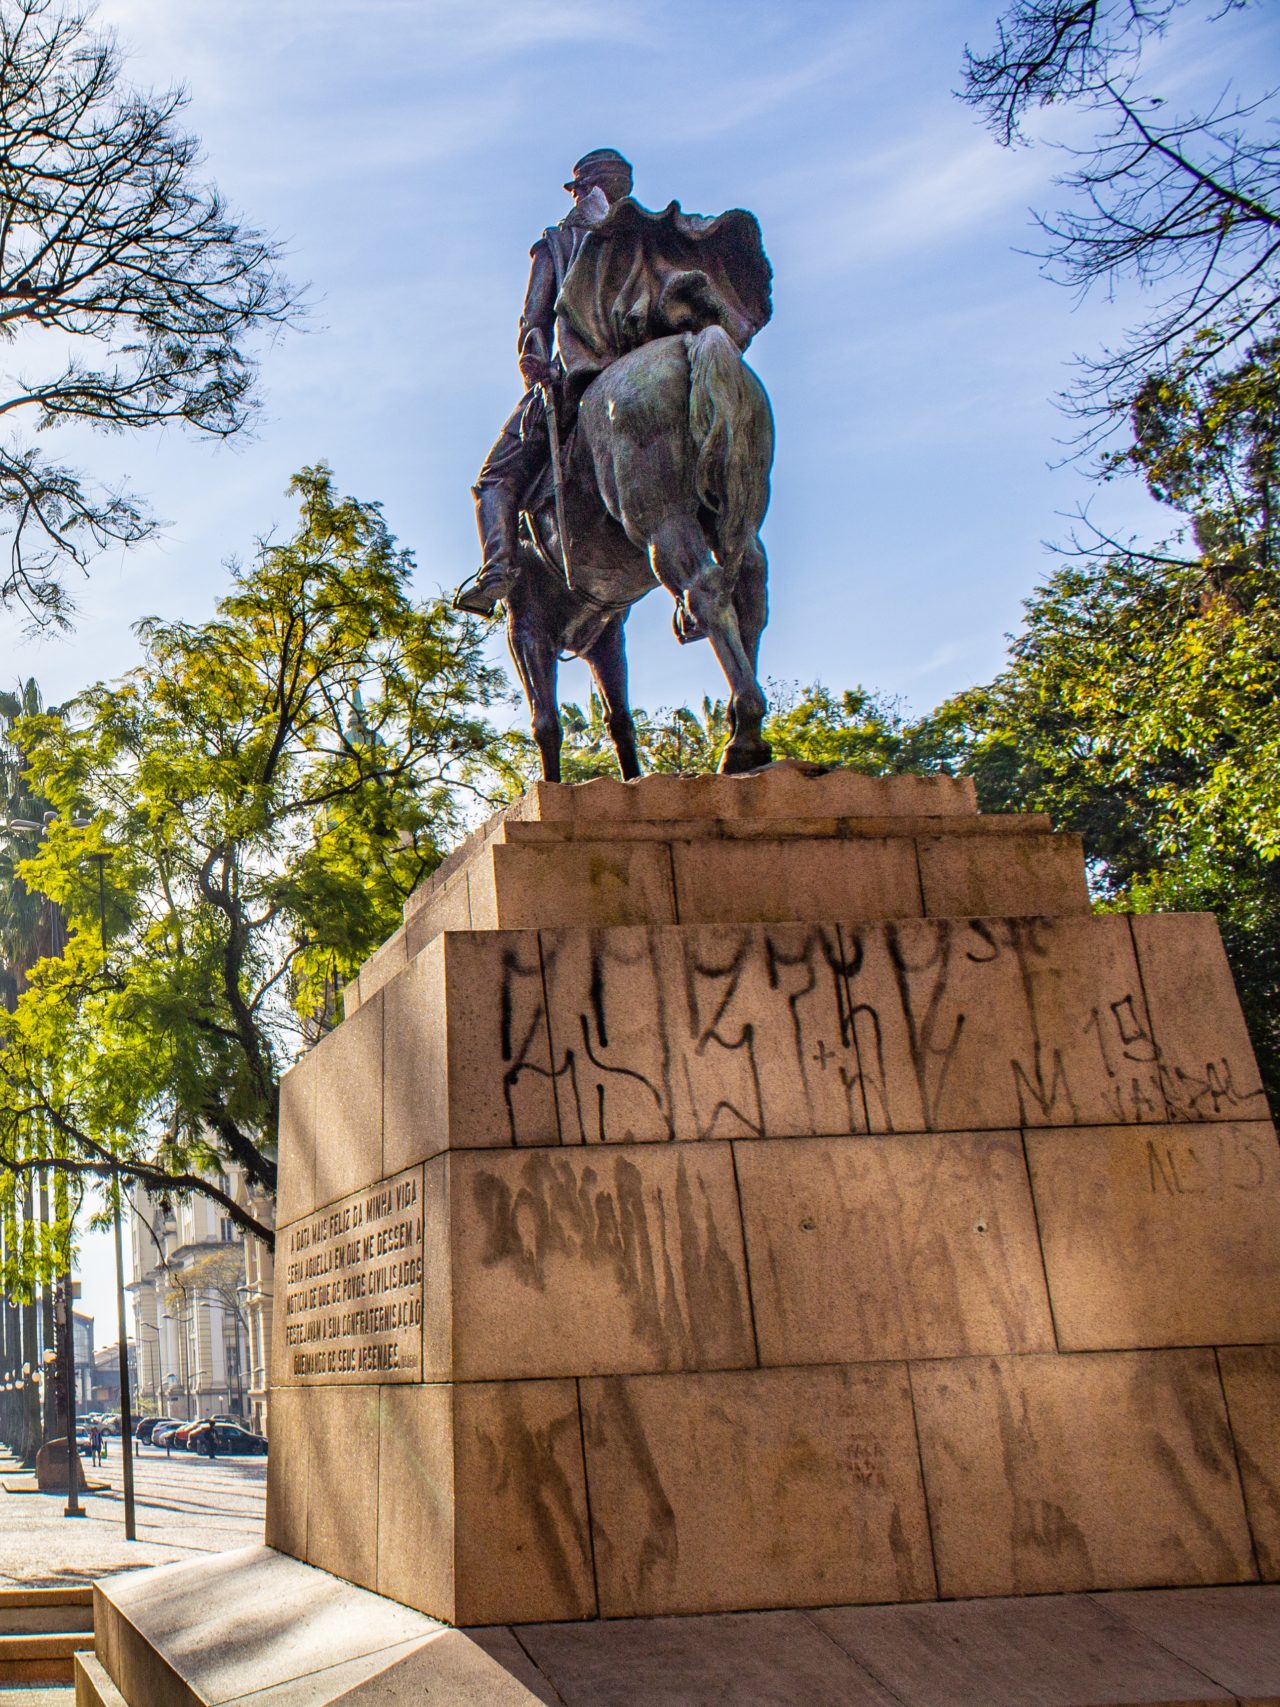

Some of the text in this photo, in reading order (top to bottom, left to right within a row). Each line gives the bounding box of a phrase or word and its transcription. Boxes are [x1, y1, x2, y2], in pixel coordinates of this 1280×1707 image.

[312, 1218, 327, 1245] MAIS
[330, 1208, 350, 1238] FELIZ
[353, 1202, 363, 1230] DA
[366, 1190, 393, 1224] MINHA
[396, 1179, 418, 1211] VIDA
[306, 1250, 332, 1279] AQUELLA
[334, 1245, 345, 1270] EM
[347, 1239, 361, 1269] QUE
[363, 1235, 375, 1261] ME
[377, 1220, 413, 1257] DESSEM
[416, 1217, 422, 1245] A
[332, 1280, 341, 1303] OS
[343, 1273, 366, 1302] POVOS
[369, 1257, 422, 1296] CIVILISADOS
[329, 1315, 340, 1339] SUA
[338, 1348, 356, 1373] SEUS
